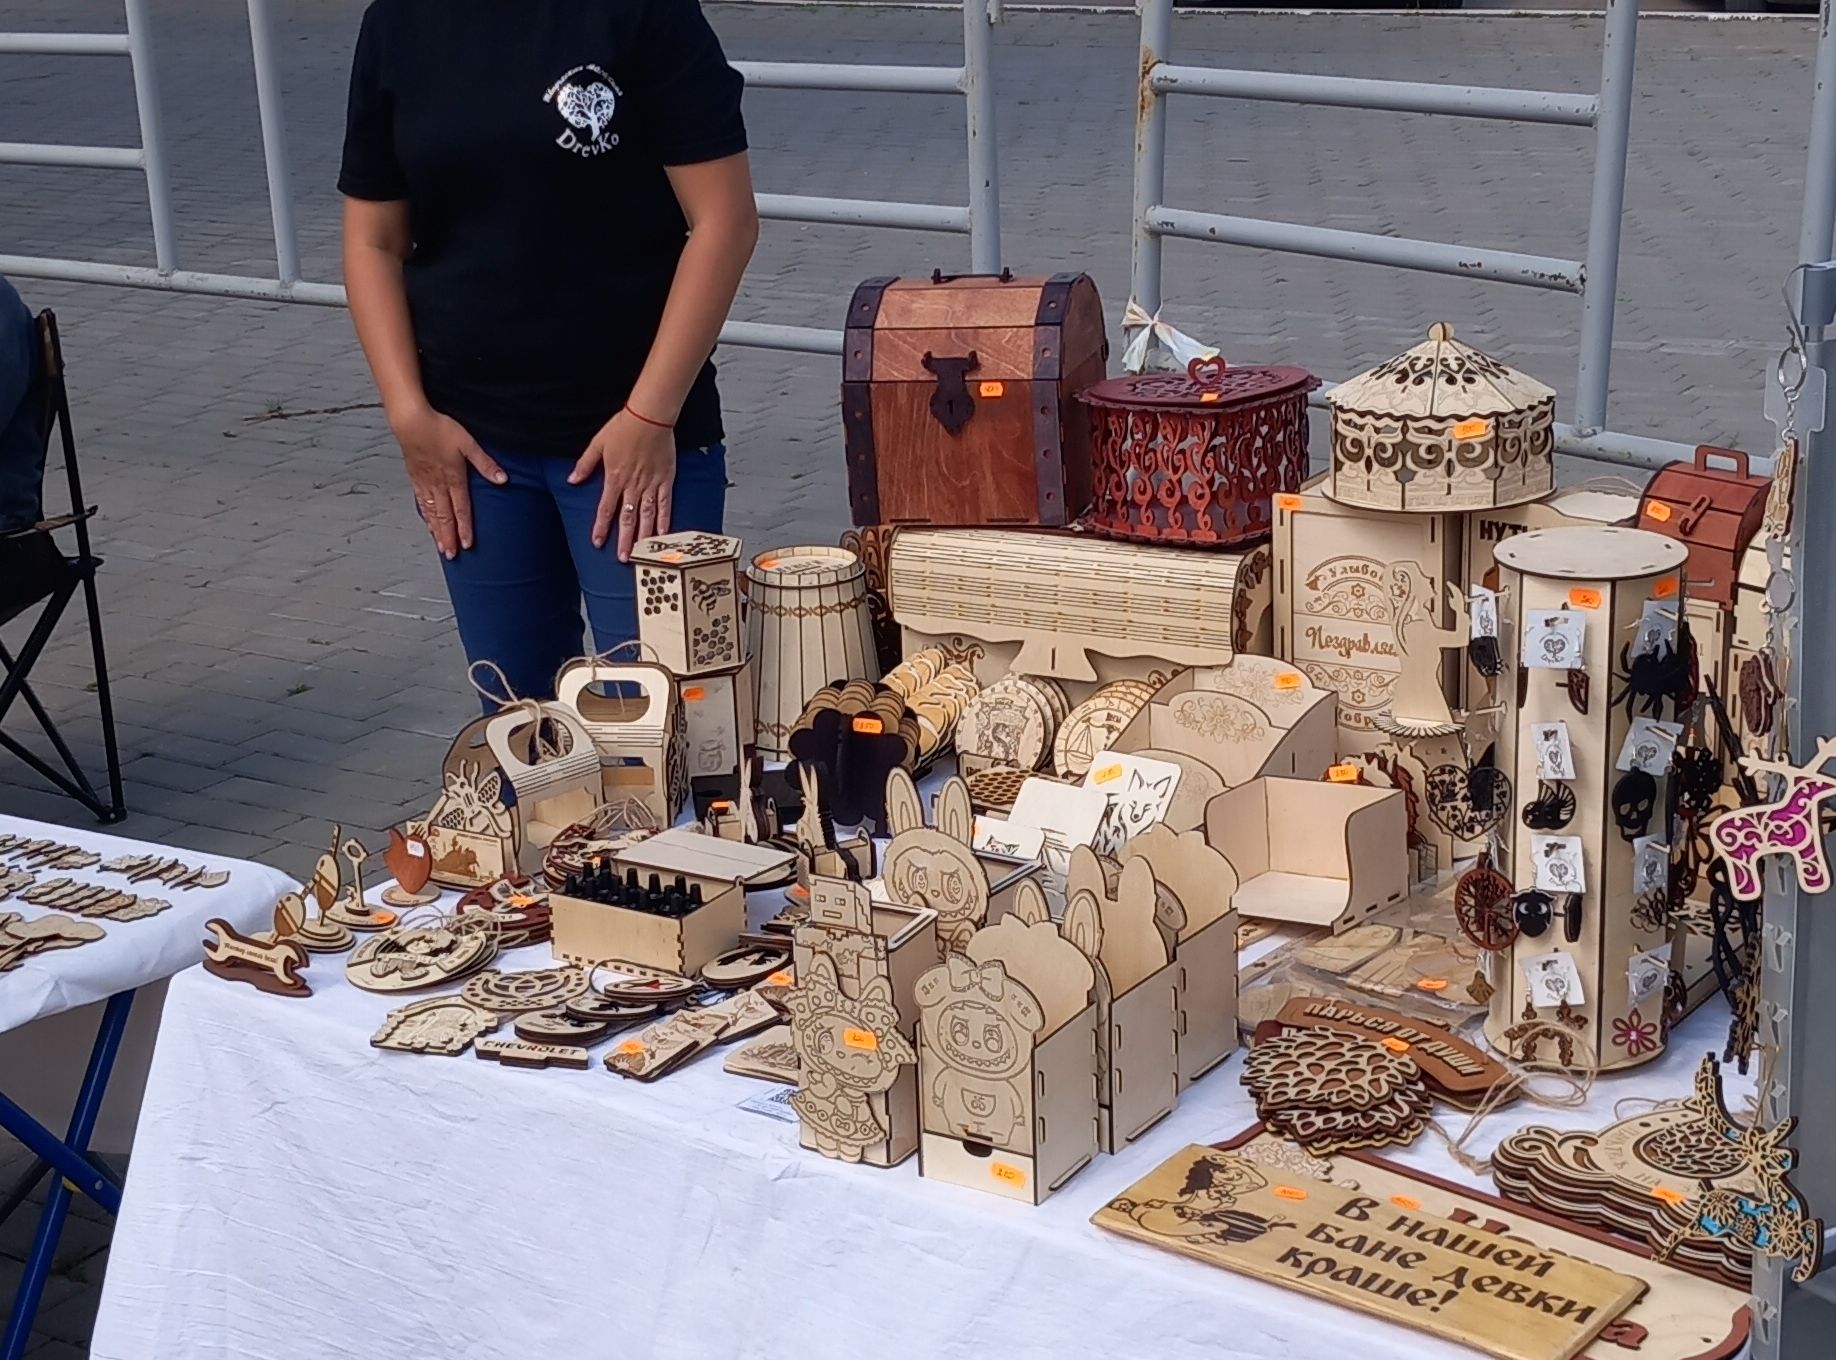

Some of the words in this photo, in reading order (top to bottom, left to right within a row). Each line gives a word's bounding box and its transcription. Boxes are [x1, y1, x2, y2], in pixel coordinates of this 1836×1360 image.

[1305, 625, 1398, 659] Поздравля
[1338, 707, 1376, 728] обр
[483, 1041, 581, 1056] CHEVROLET
[1303, 1002, 1401, 1034] ПАРЬСЯ
[1417, 1040, 1486, 1077] ДУШИ
[1334, 1197, 1381, 1226] В
[1392, 1214, 1556, 1279] нашей
[1275, 1245, 1460, 1314] краше!
[1432, 1268, 1598, 1326] девки
